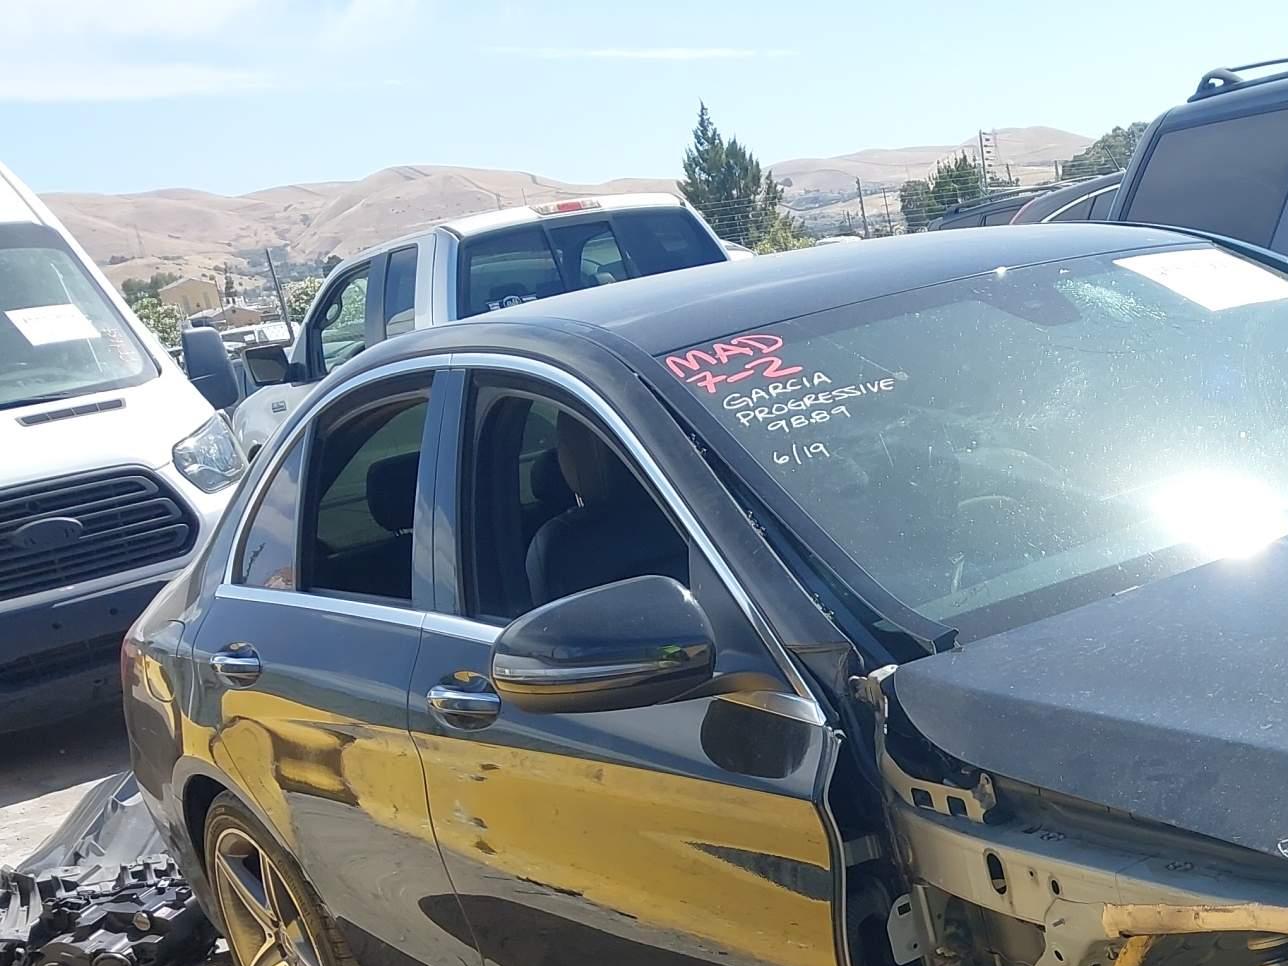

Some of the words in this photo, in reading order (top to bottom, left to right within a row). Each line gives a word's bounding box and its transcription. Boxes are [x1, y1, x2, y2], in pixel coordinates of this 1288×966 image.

[665, 334, 783, 378] MAD
[723, 372, 832, 409] GARCIA
[735, 378, 896, 427] PROGRESSIVE
[773, 443, 830, 465] 6/19
